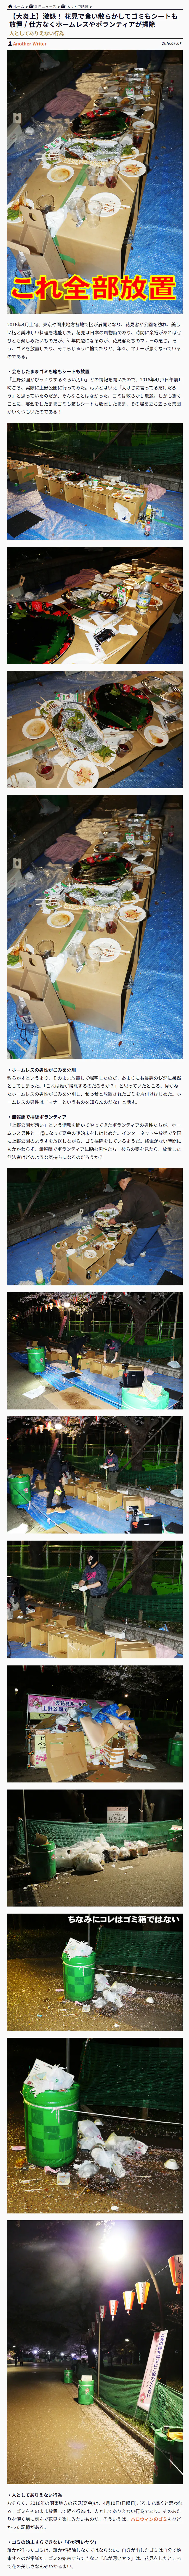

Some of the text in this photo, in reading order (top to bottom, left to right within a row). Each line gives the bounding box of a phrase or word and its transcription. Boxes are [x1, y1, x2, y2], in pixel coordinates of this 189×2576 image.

[147, 2333, 166, 2398] ごみの持ち帰りにご協力ください
